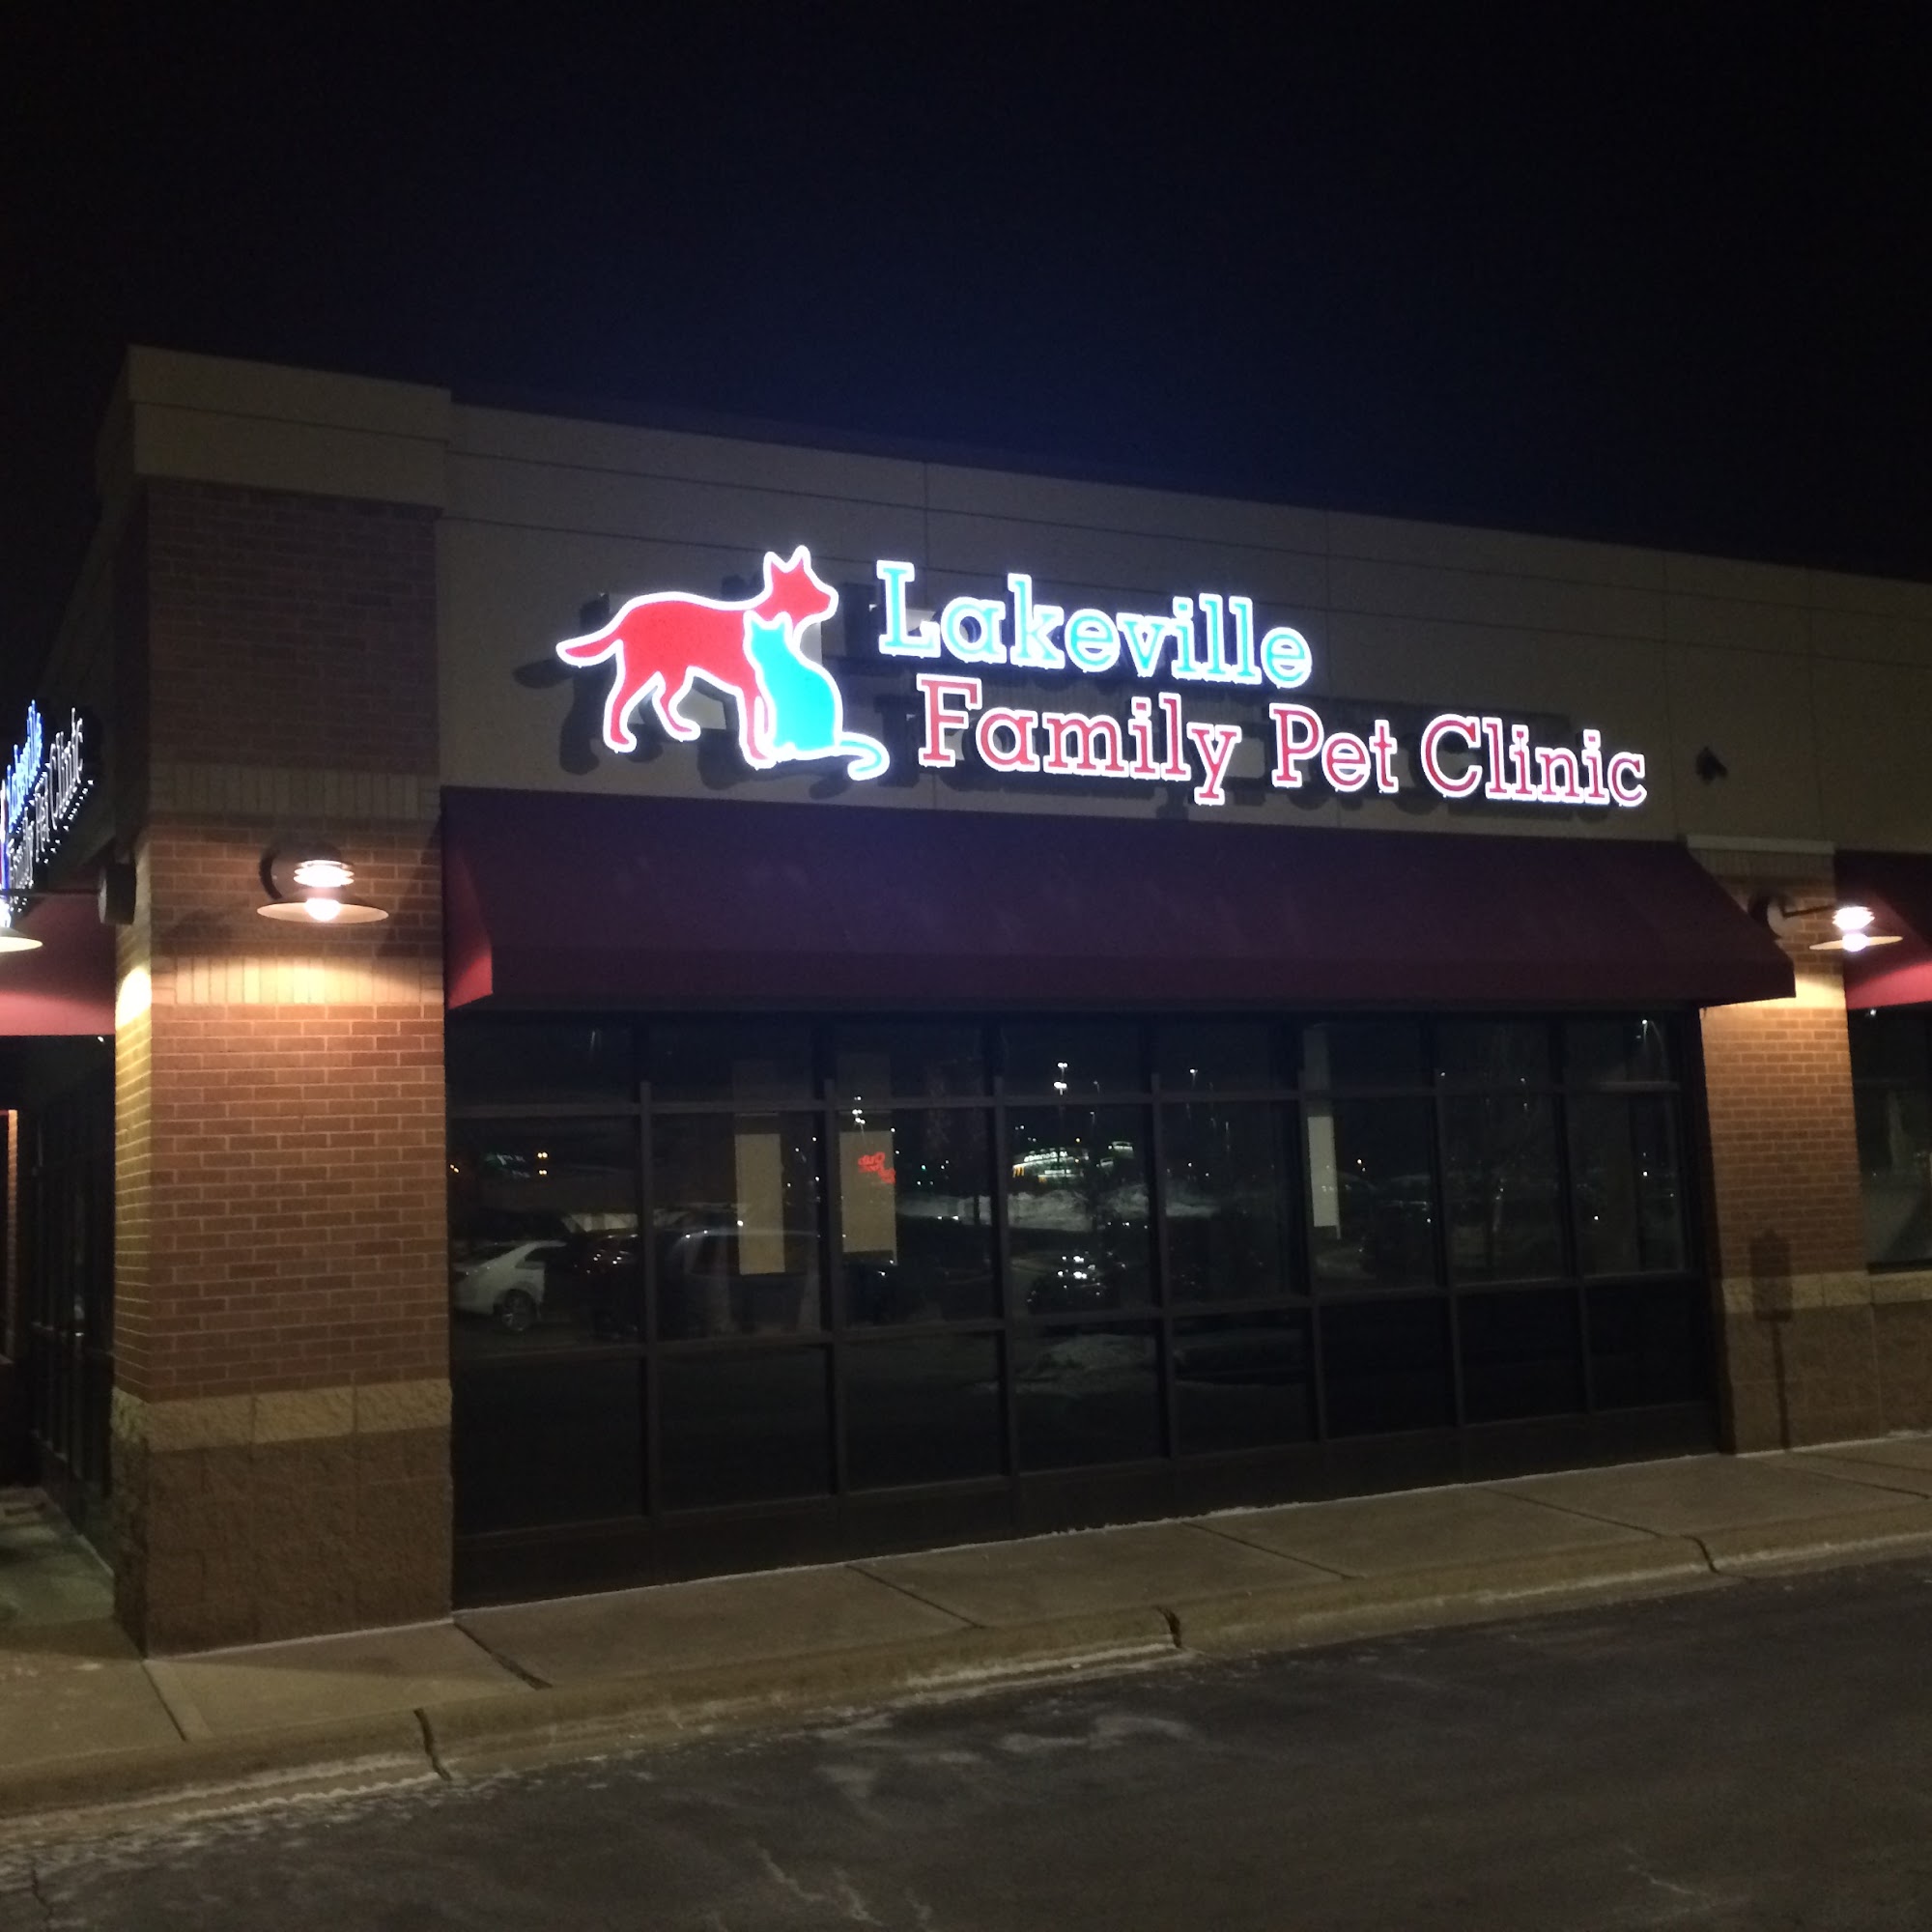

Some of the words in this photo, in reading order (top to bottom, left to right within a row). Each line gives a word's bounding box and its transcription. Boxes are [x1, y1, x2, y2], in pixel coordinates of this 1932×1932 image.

[876, 559, 1313, 688] Lakeville
[917, 673, 1242, 806] Family
[1269, 703, 1398, 793] Pet
[1420, 714, 1647, 808] Clinic
